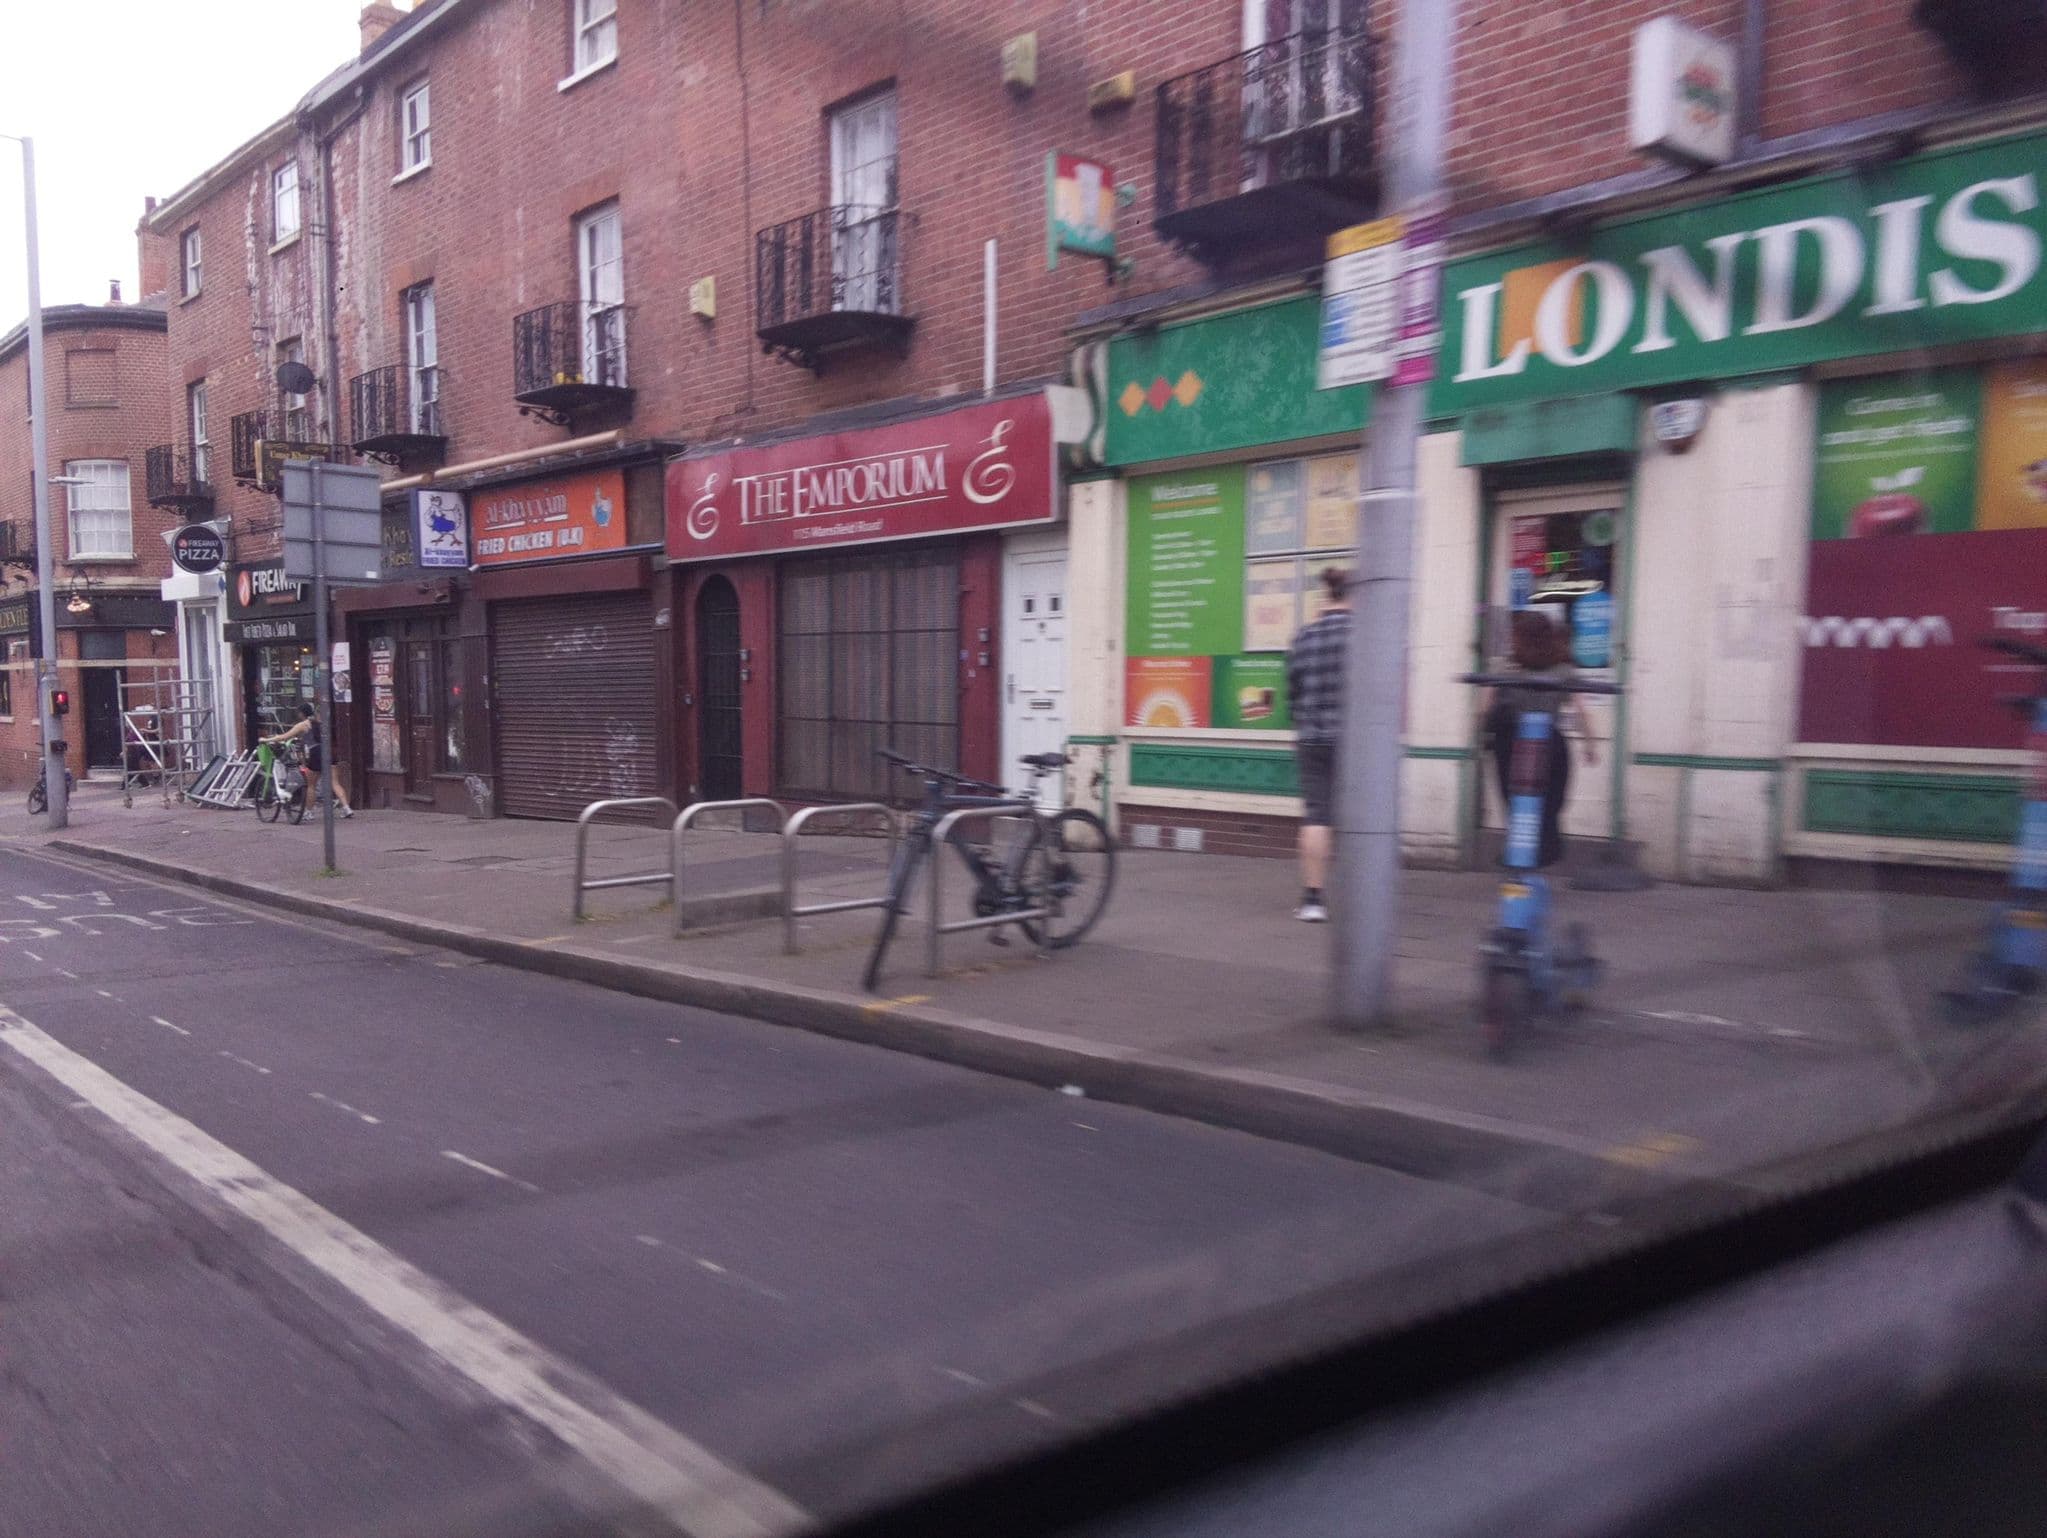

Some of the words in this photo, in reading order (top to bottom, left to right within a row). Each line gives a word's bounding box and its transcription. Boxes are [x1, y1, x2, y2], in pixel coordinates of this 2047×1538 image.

[1452, 173, 2043, 383] LONDIS
[732, 476, 788, 525] THE
[792, 450, 948, 517] EMPORIUM
[179, 549, 219, 560] PIZZA
[477, 537, 506, 555] FRIED
[508, 530, 554, 552] CHICKEN
